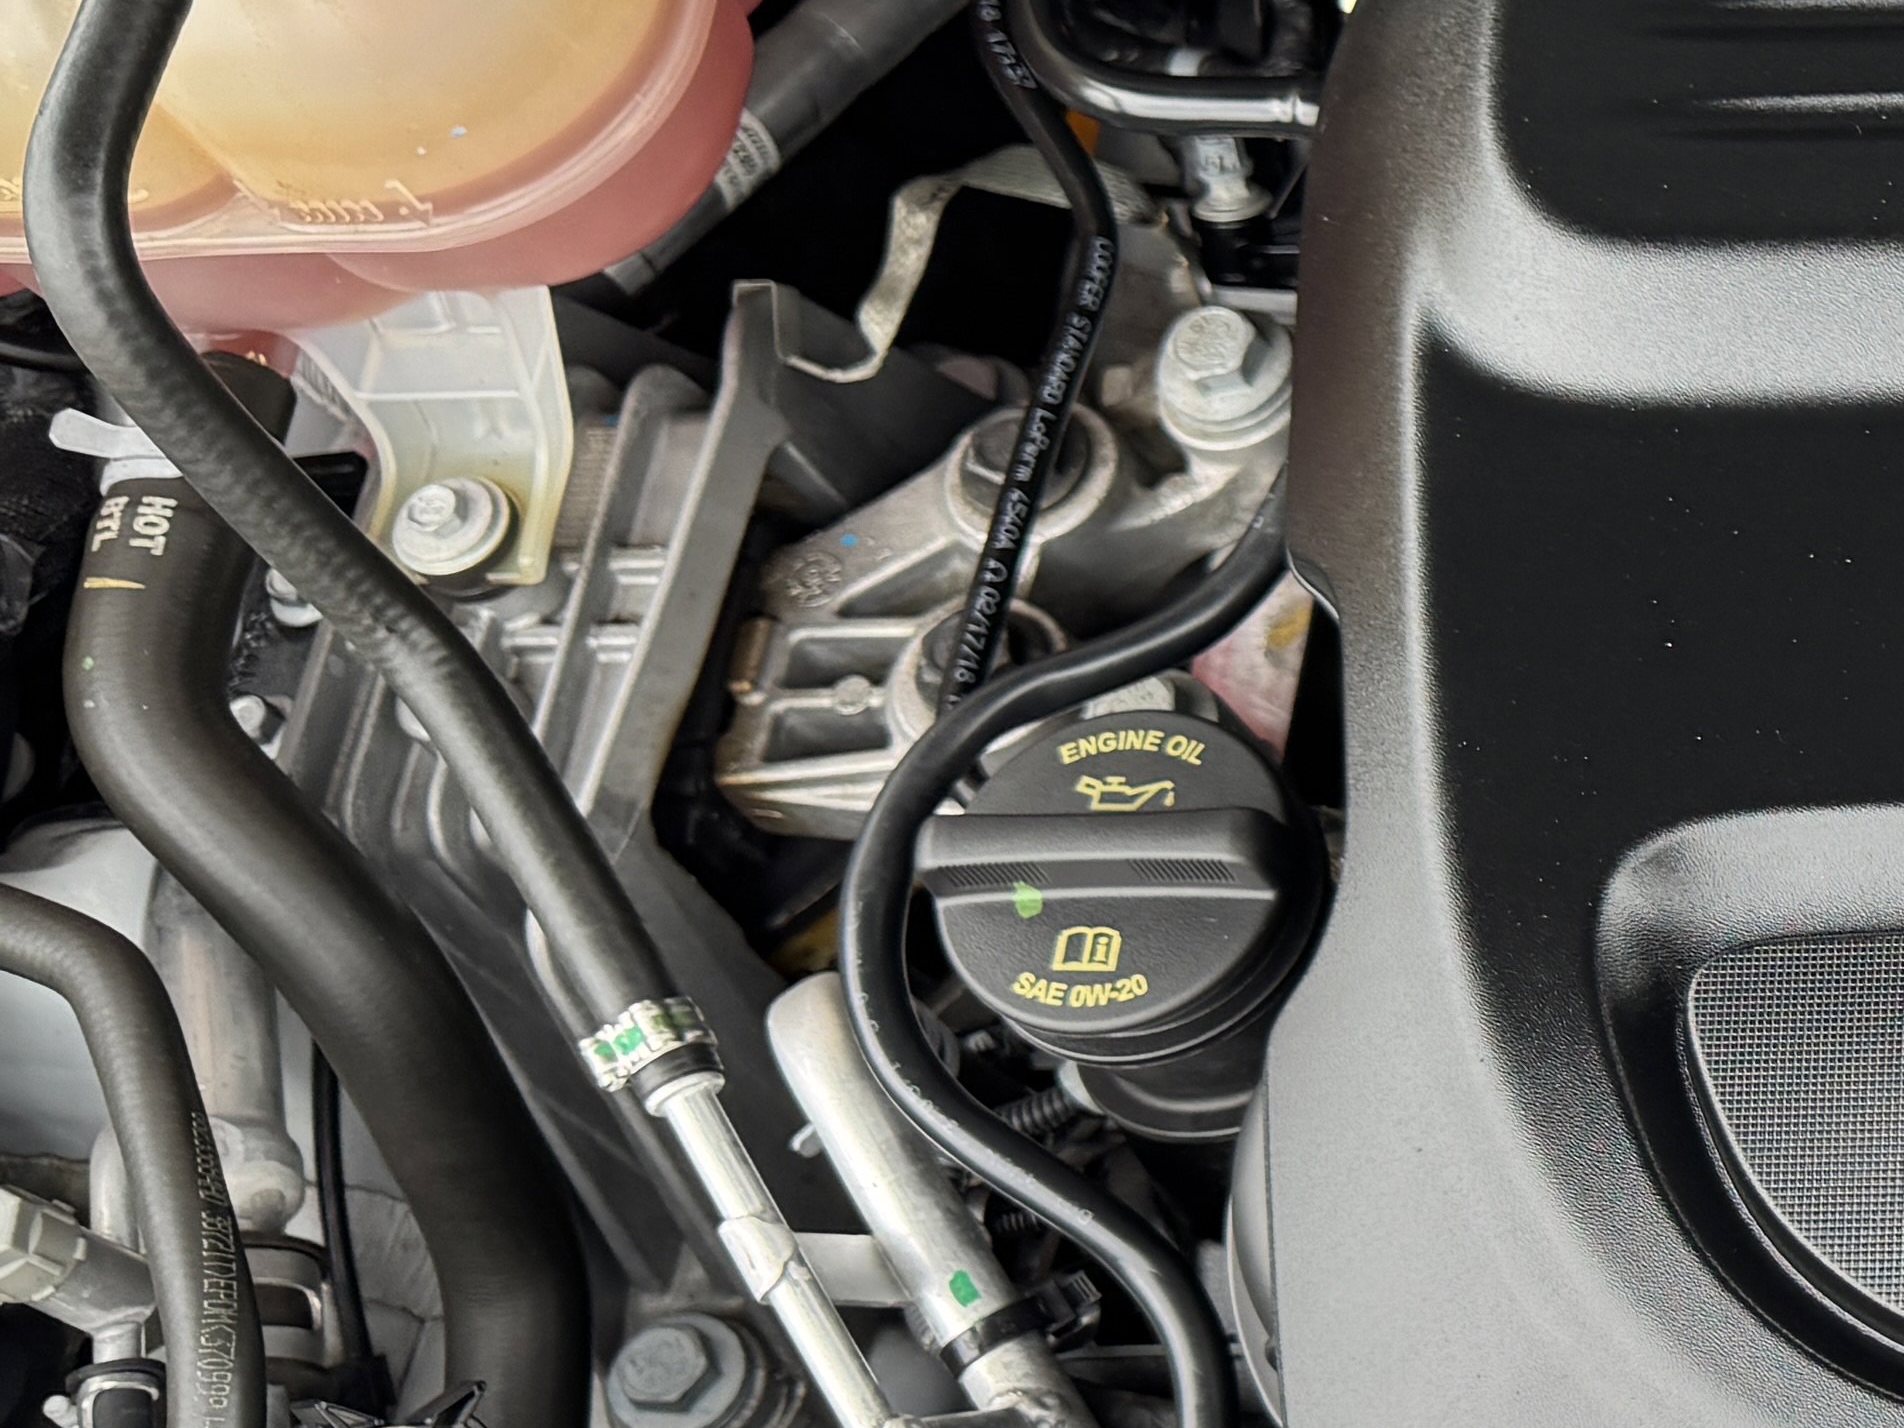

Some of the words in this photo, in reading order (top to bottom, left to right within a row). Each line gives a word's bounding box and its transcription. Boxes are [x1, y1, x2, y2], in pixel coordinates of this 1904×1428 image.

[129, 496, 178, 556] HOT
[1058, 730, 1166, 766] ENGINE
[1166, 734, 1207, 766] OIL
[1012, 971, 1066, 1007] SAE
[1068, 972, 1149, 1008] 0W-20
